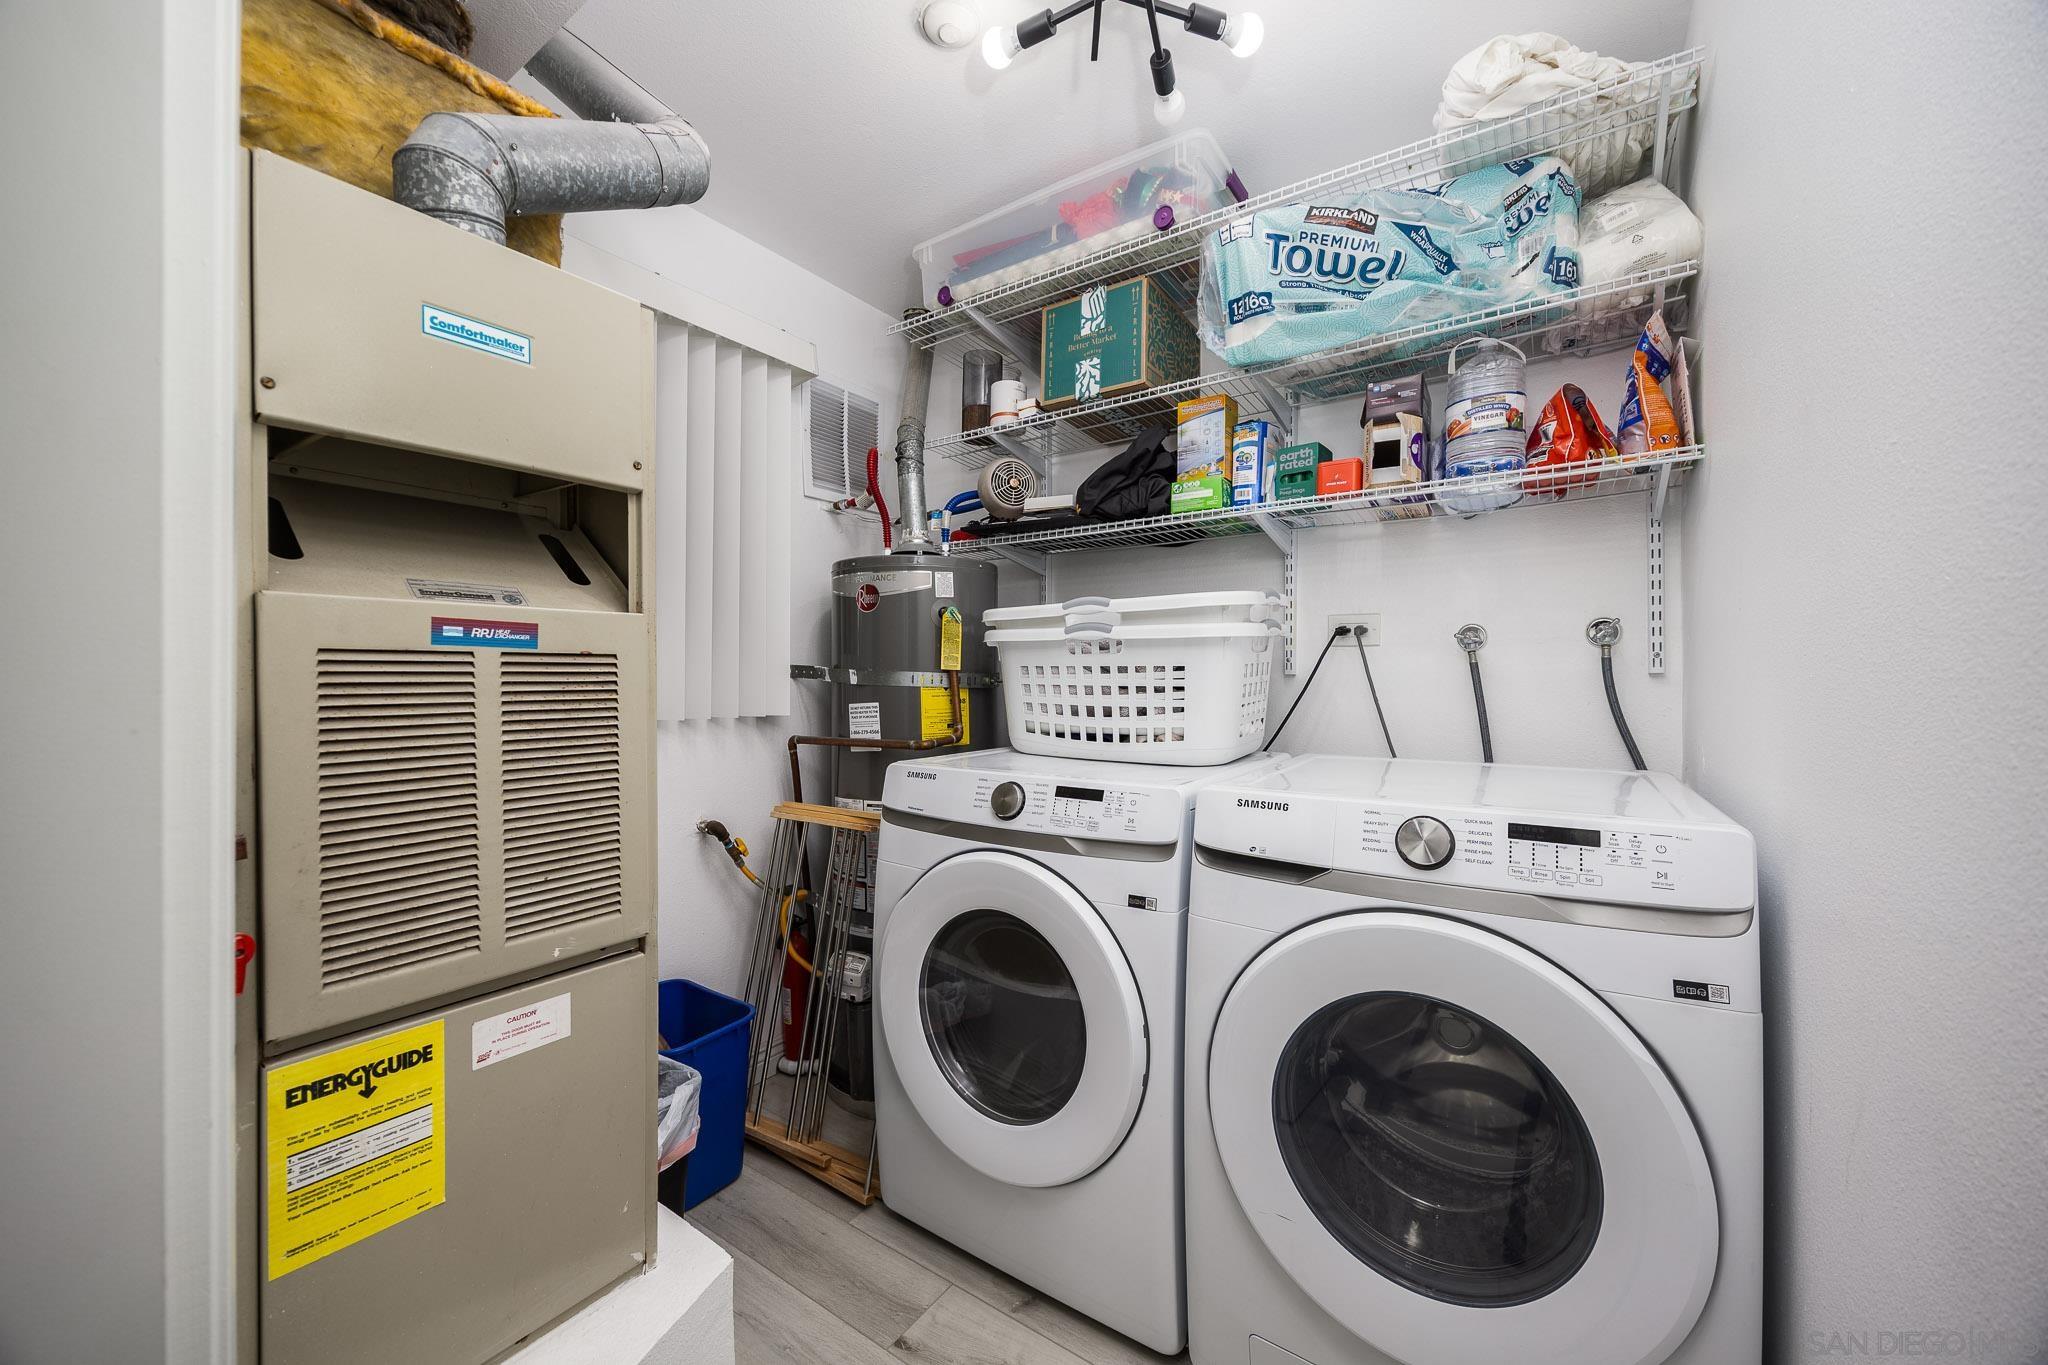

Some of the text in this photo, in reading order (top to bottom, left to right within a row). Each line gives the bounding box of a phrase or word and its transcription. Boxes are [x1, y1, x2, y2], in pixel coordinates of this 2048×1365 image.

[1310, 206, 1377, 226] KIRKLAND
[1300, 231, 1380, 253] PREMIUM
[1264, 231, 1404, 287] Towel
[429, 315, 525, 352] Comfortmaker
[1068, 341, 1090, 352] Better
[1091, 333, 1117, 345] Market
[1473, 411, 1504, 421] VINEGAR
[1280, 447, 1313, 461] earth
[1280, 458, 1313, 471] rated
[470, 627, 495, 639] RPJ
[494, 633, 530, 641] EXCHANGER
[907, 771, 937, 781] SAMSUNG
[1237, 798, 1289, 812] SAMSUNG
[506, 1009, 538, 1024] CAUTION
[285, 1043, 433, 1109] ENERGYGUIDE
